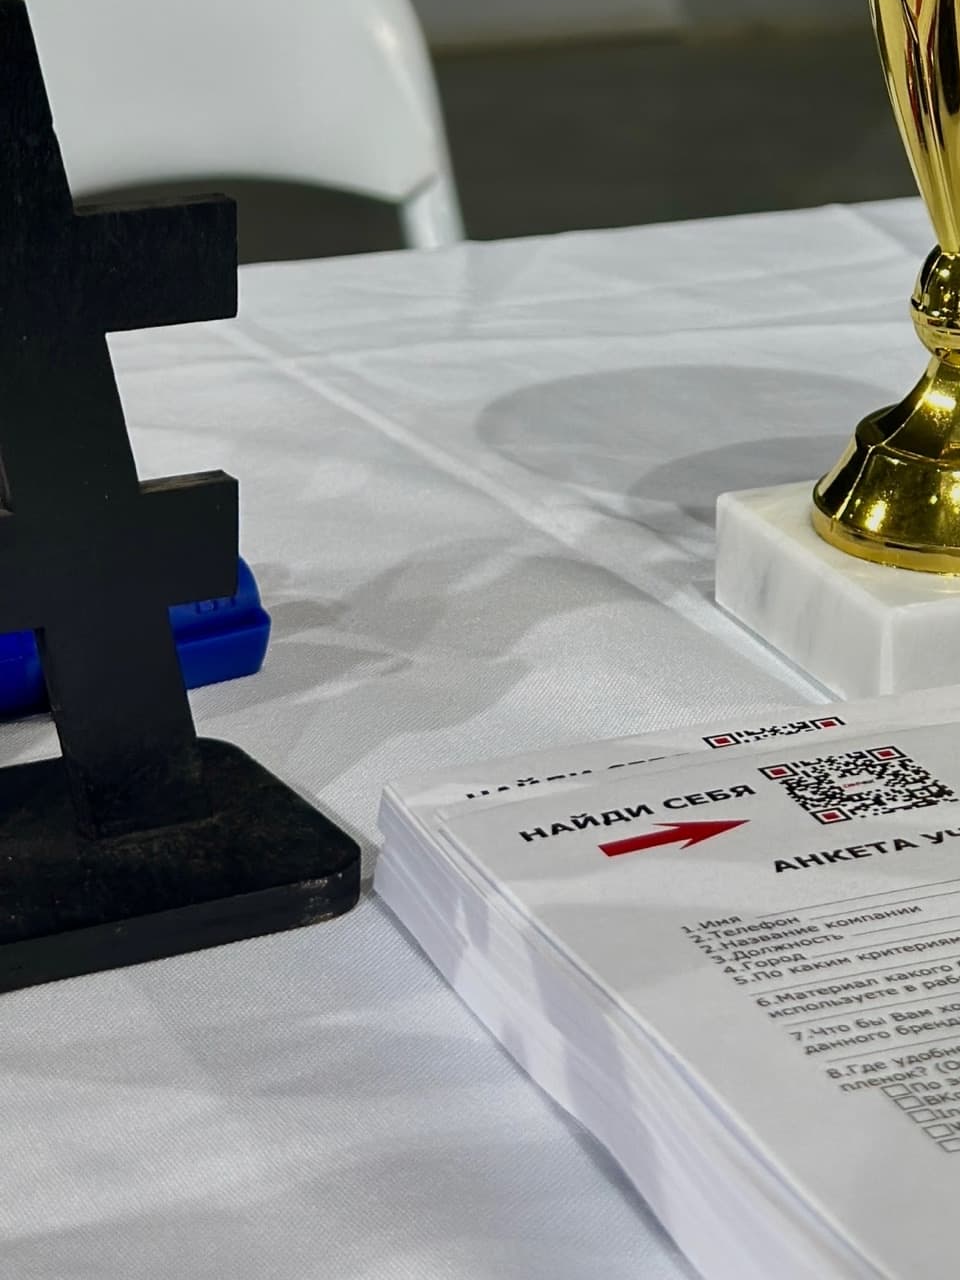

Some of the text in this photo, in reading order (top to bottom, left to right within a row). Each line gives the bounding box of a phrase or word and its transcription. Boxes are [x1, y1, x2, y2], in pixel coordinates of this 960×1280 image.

[519, 785, 756, 842] НАЙДИ СЕБЯ
[774, 837, 919, 873] АНКЕТА
[681, 916, 742, 934] 1.Имя
[689, 917, 801, 944] 2.Телефон
[699, 906, 922, 954] 2.Название компании
[710, 934, 844, 965] 3.Должность
[723, 953, 808, 974] 4.Город
[732, 970, 783, 985] 5.По
[787, 957, 852, 974] каким
[756, 978, 879, 1007] 6.Материал
[884, 965, 953, 983] какого
[768, 988, 900, 1019] используете
[903, 985, 918, 993] в
[789, 1024, 851, 1041] 7.Что
[854, 1017, 887, 1029] бы
[888, 1009, 933, 1022] Вам
[804, 1031, 891, 1056] данного
[825, 1061, 888, 1079] 8.Где
[839, 1066, 928, 1092] пленок?
[909, 1081, 943, 1093] По
